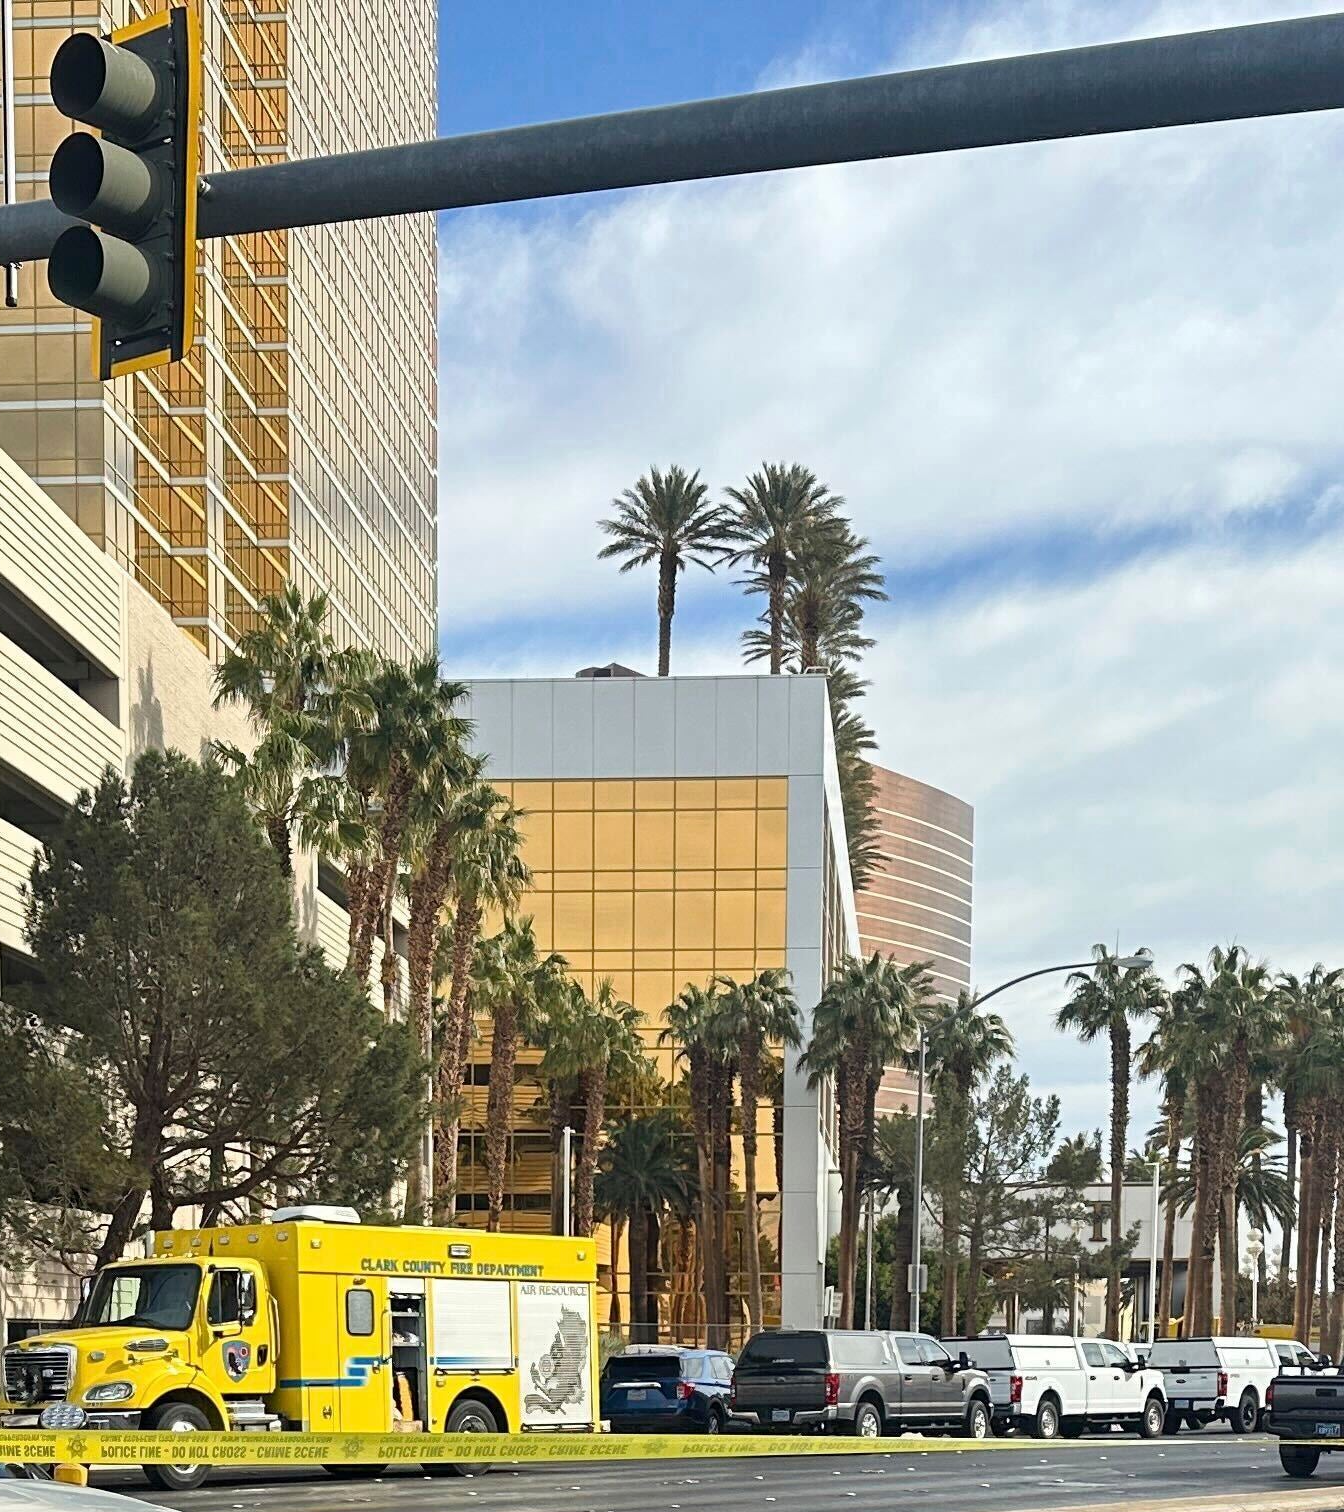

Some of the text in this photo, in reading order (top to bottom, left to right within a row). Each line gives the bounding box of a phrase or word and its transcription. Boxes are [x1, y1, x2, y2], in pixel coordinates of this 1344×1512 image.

[361, 1258, 544, 1277] CLARK COUNTY FIRE DEPARTMENT
[520, 1285, 587, 1297] AIR RESOURCE
